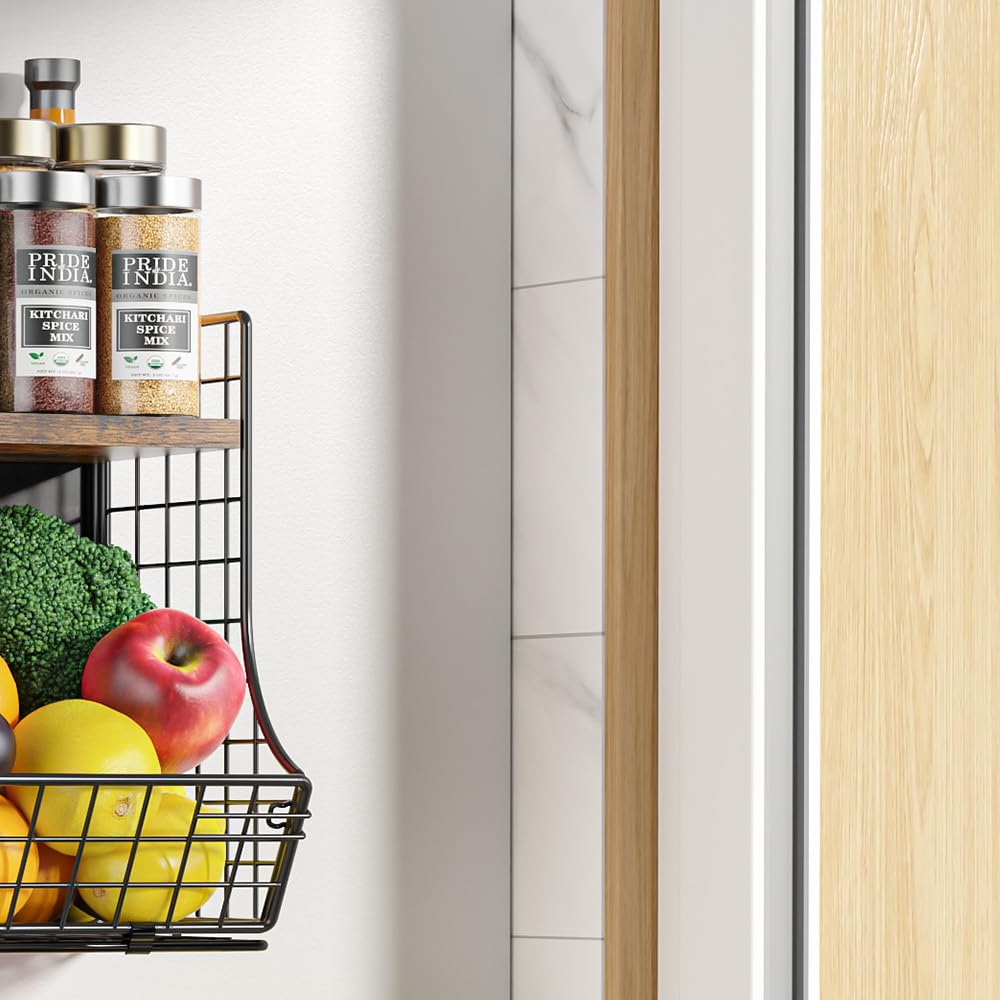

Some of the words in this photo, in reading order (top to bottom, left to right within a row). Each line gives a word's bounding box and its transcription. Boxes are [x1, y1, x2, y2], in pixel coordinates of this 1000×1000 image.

[28, 252, 90, 269] PRIDE
[123, 257, 189, 273] PRIDE
[29, 310, 88, 321] KITCHARI
[124, 313, 187, 324] KITCHARI
[42, 321, 80, 331] SPICE
[136, 325, 176, 334] SPICE
[50, 333, 74, 342] MIX
[144, 336, 169, 346] MIX
